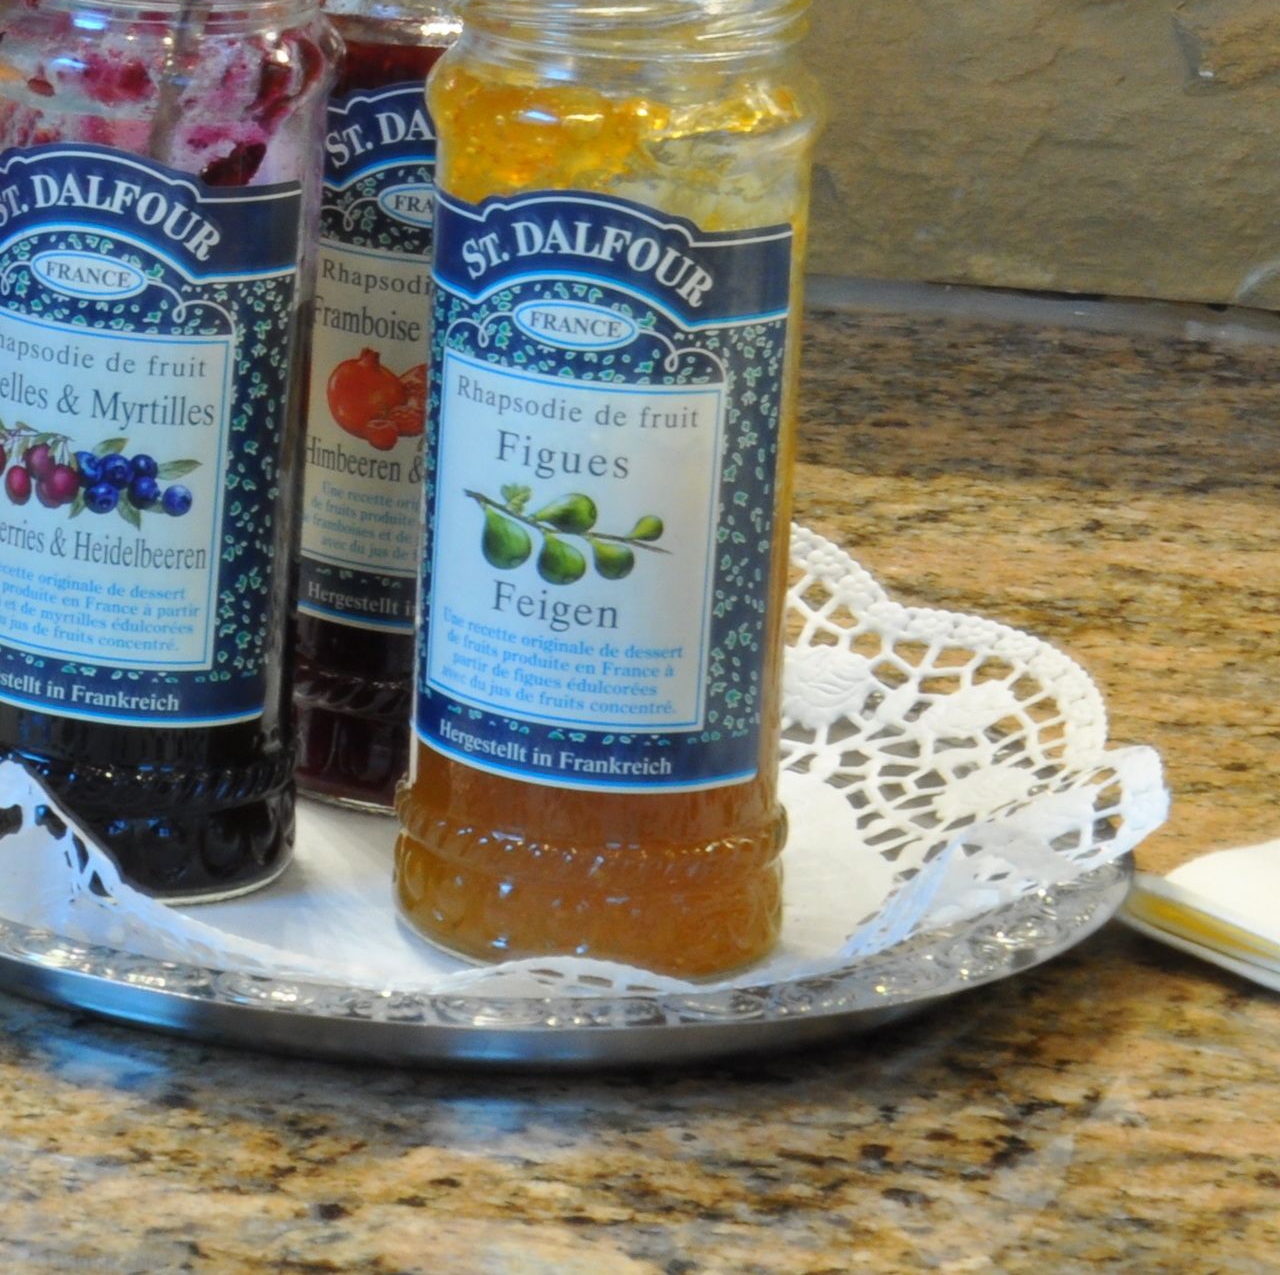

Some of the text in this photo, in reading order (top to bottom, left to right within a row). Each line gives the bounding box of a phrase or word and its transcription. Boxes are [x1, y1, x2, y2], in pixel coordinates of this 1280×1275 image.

[325, 124, 374, 168] ST.
[30, 172, 221, 262] DALFOUR
[44, 260, 132, 290] FRANCE
[322, 258, 433, 296] Rhapsodi
[462, 219, 714, 308] ST. DALFOUR
[530, 311, 622, 338] FRANCE
[106, 351, 136, 374] de
[148, 355, 207, 377] fruit
[57, 384, 81, 415] &
[91, 388, 215, 430] Myrtilles
[457, 375, 700, 429] Rhapsodie de fruit
[496, 429, 630, 480] Figues
[49, 527, 67, 558] &
[73, 531, 207, 570] Heidelbeeren
[2, 581, 56, 603] produite
[62, 596, 80, 607] en
[85, 593, 138, 616] France
[143, 602, 152, 617] à
[157, 604, 200, 620] partir
[38, 573, 103, 595] originale
[107, 582, 126, 597] de
[130, 585, 186, 600] dessert
[308, 581, 399, 615] Hergestellt
[40, 608, 107, 631] myrtilles
[111, 613, 193, 635] édulcorées
[491, 580, 618, 632] Feigen
[32, 621, 49, 637] de
[53, 625, 94, 645] fruits
[98, 633, 180, 653] concentré.
[469, 621, 516, 644] recette
[521, 635, 593, 656] originale
[600, 643, 619, 659] de
[625, 645, 683, 659] dessert
[492, 662, 509, 679] de
[514, 668, 562, 689] figues
[567, 677, 657, 697] édulcorées
[502, 650, 569, 671] produite
[575, 662, 595, 675] en
[602, 660, 662, 678] France
[665, 664, 674, 678] à
[46, 680, 65, 701] in
[71, 684, 180, 712] Frankreich
[470, 674, 486, 691] du
[489, 679, 511, 697] jus
[515, 687, 534, 704] de
[539, 691, 584, 711] fruits
[590, 699, 677, 715] concentré.
[439, 718, 672, 775] Hergestellt in Frankreich
